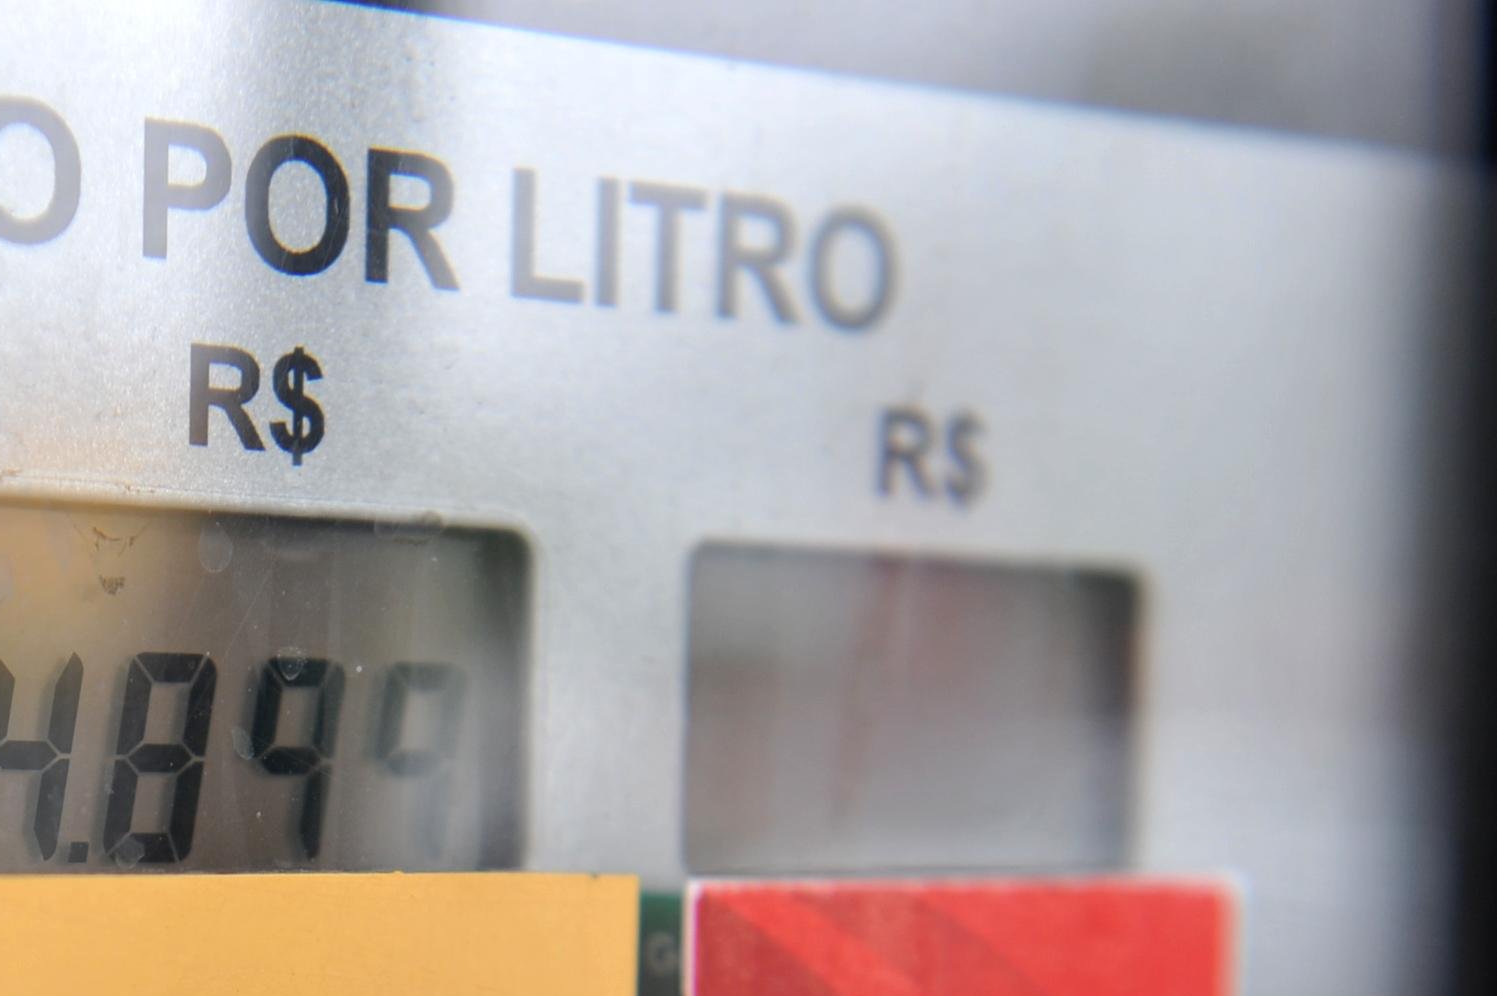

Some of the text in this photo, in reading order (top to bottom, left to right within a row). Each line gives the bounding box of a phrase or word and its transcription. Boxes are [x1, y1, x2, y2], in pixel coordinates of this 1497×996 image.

[142, 117, 459, 291] POR
[510, 167, 900, 331] LITRO
[188, 343, 325, 466] R$
[874, 405, 988, 507] R$
